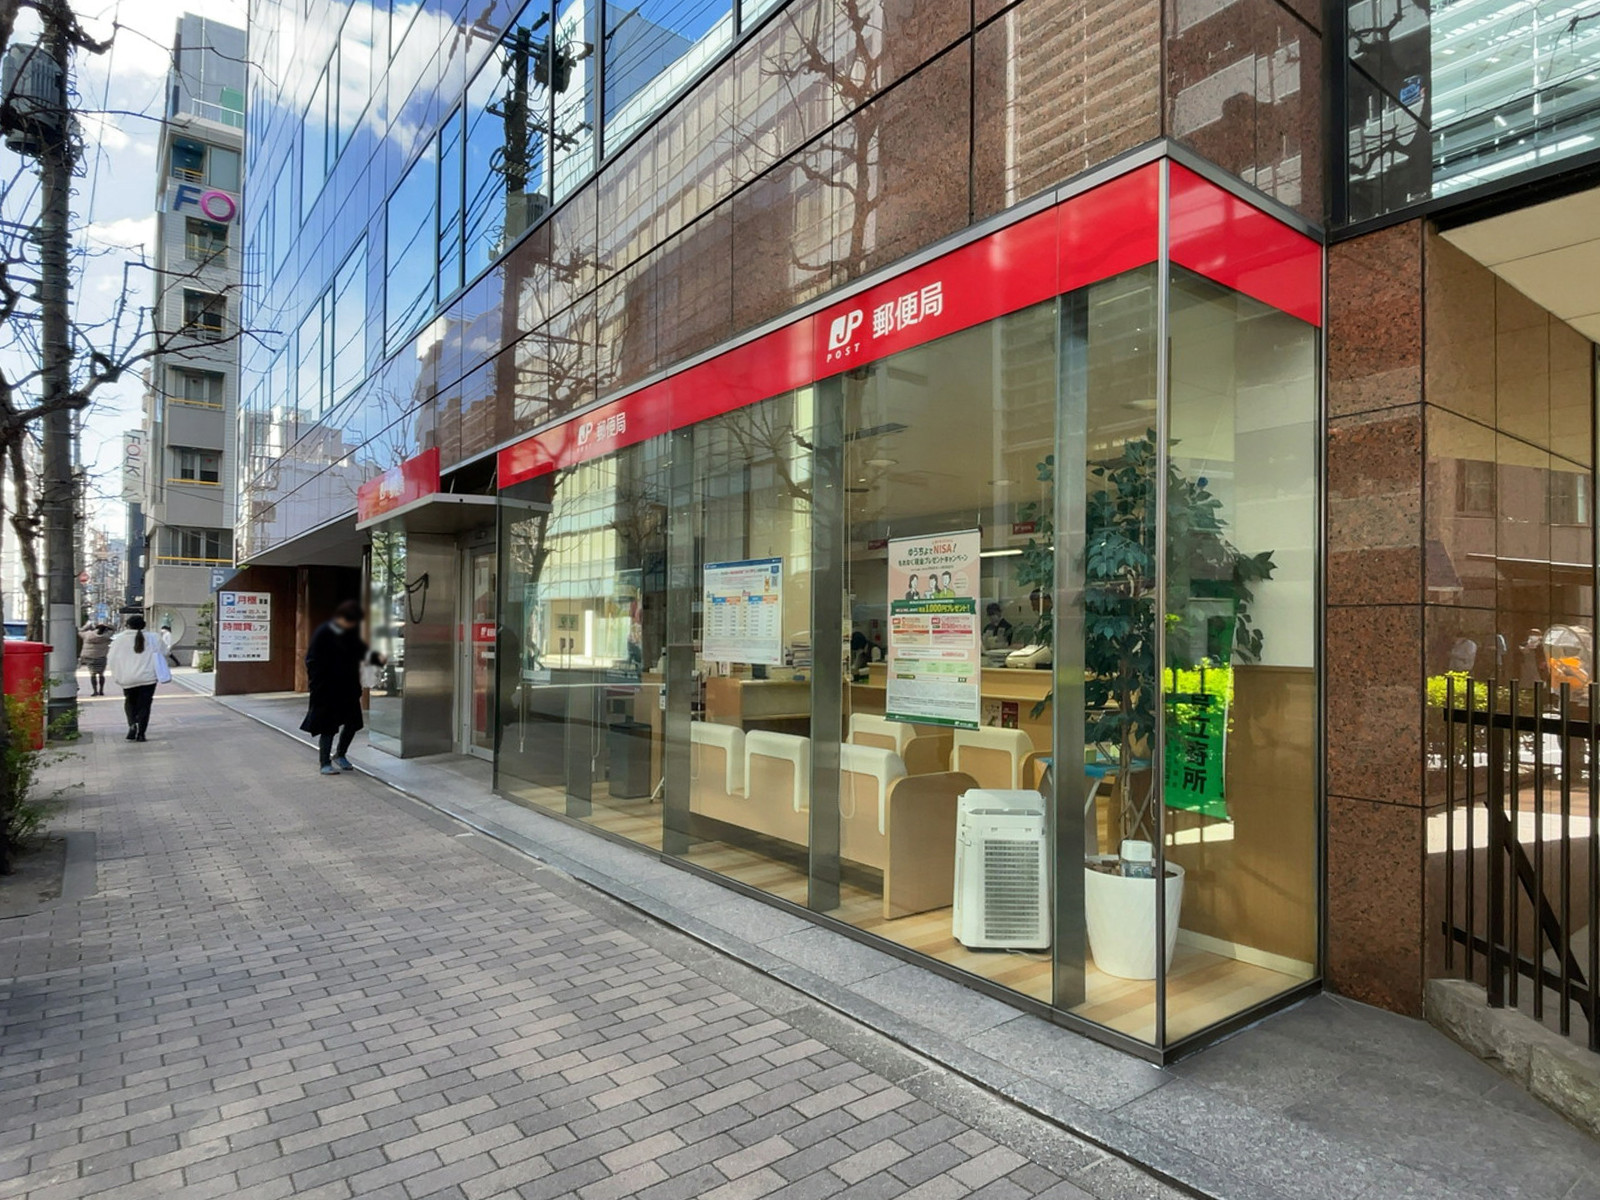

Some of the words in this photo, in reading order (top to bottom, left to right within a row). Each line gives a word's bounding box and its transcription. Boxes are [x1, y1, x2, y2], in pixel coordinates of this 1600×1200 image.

[173, 184, 241, 225] FO
[872, 281, 943, 339] 郵便局
[826, 342, 861, 363] POST
[126, 433, 142, 478] FOLK
[212, 575, 225, 588] P
[222, 593, 235, 606] P
